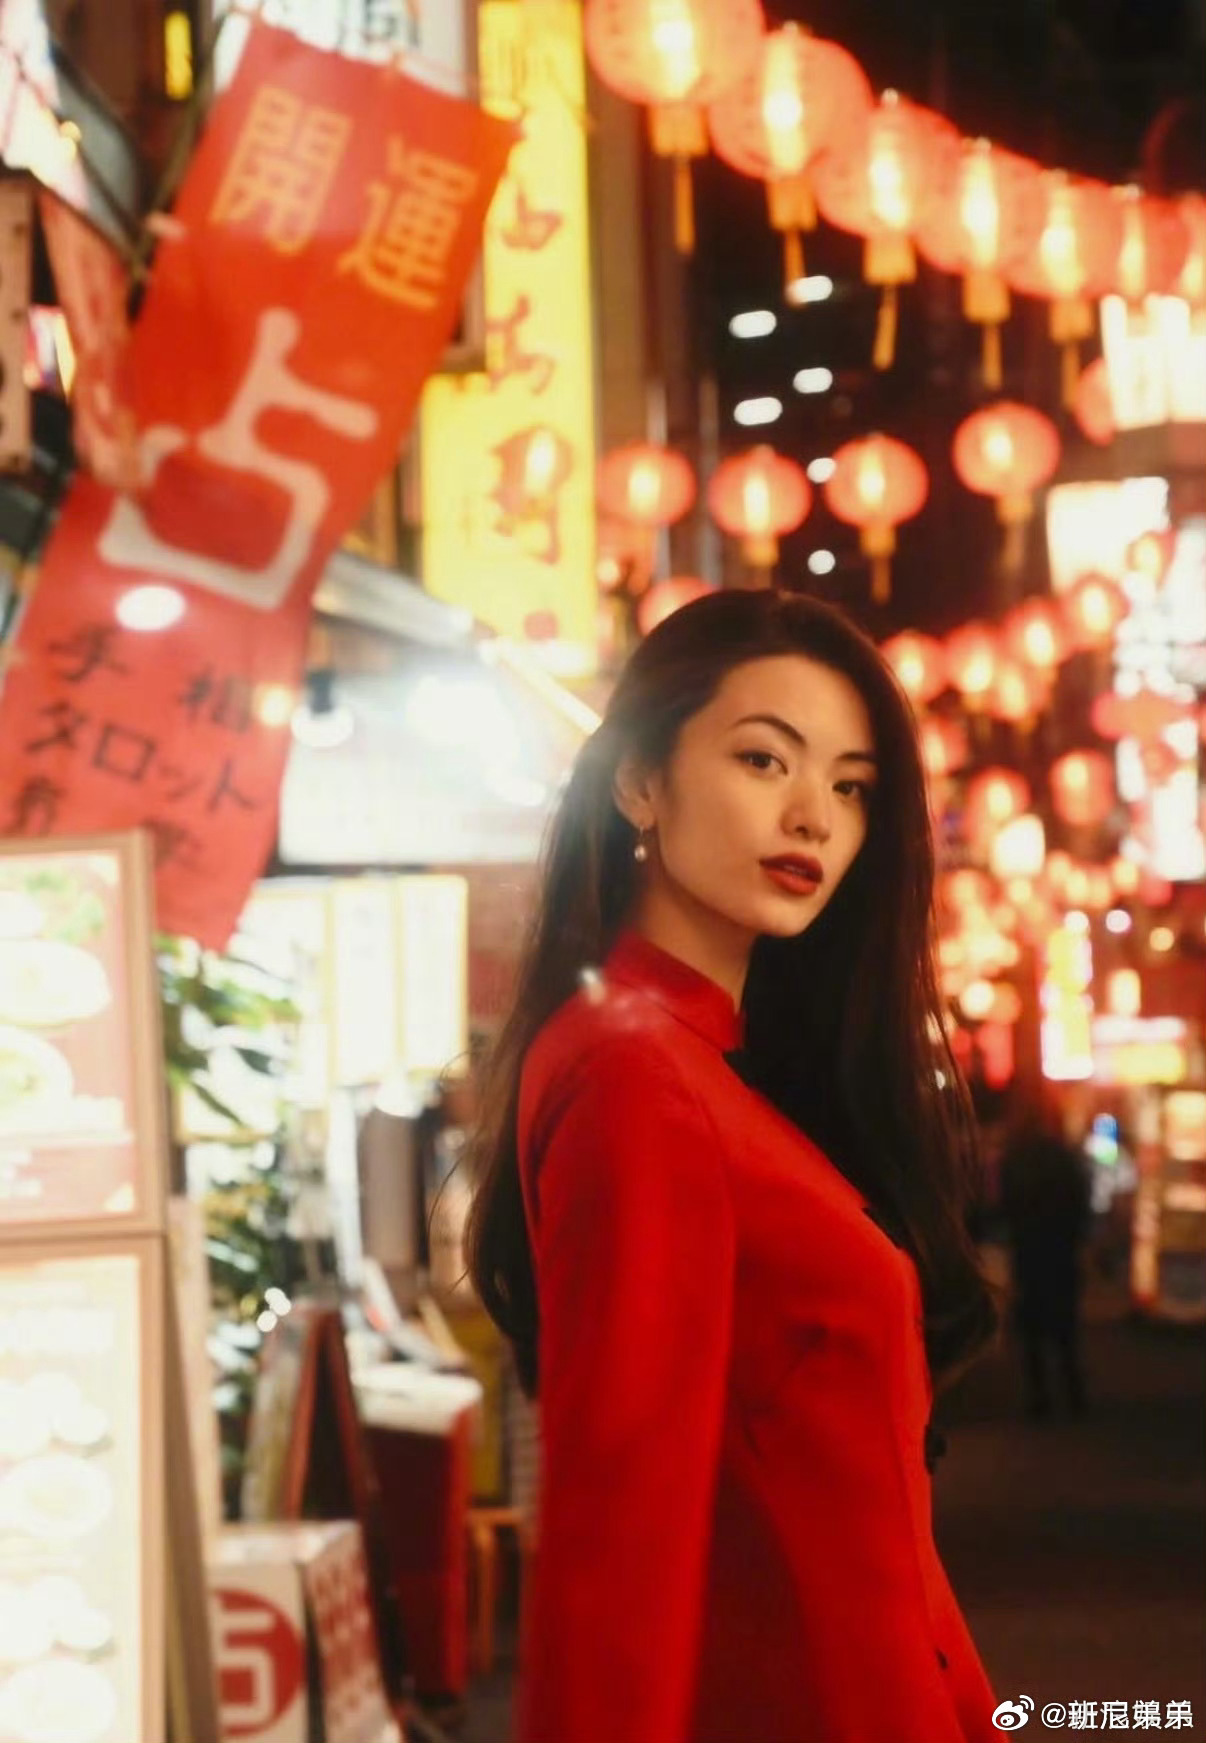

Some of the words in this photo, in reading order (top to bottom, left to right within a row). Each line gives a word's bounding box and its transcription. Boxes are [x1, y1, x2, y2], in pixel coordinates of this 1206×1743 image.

[208, 84, 480, 309] 開運
[23, 698, 258, 813] タロット
